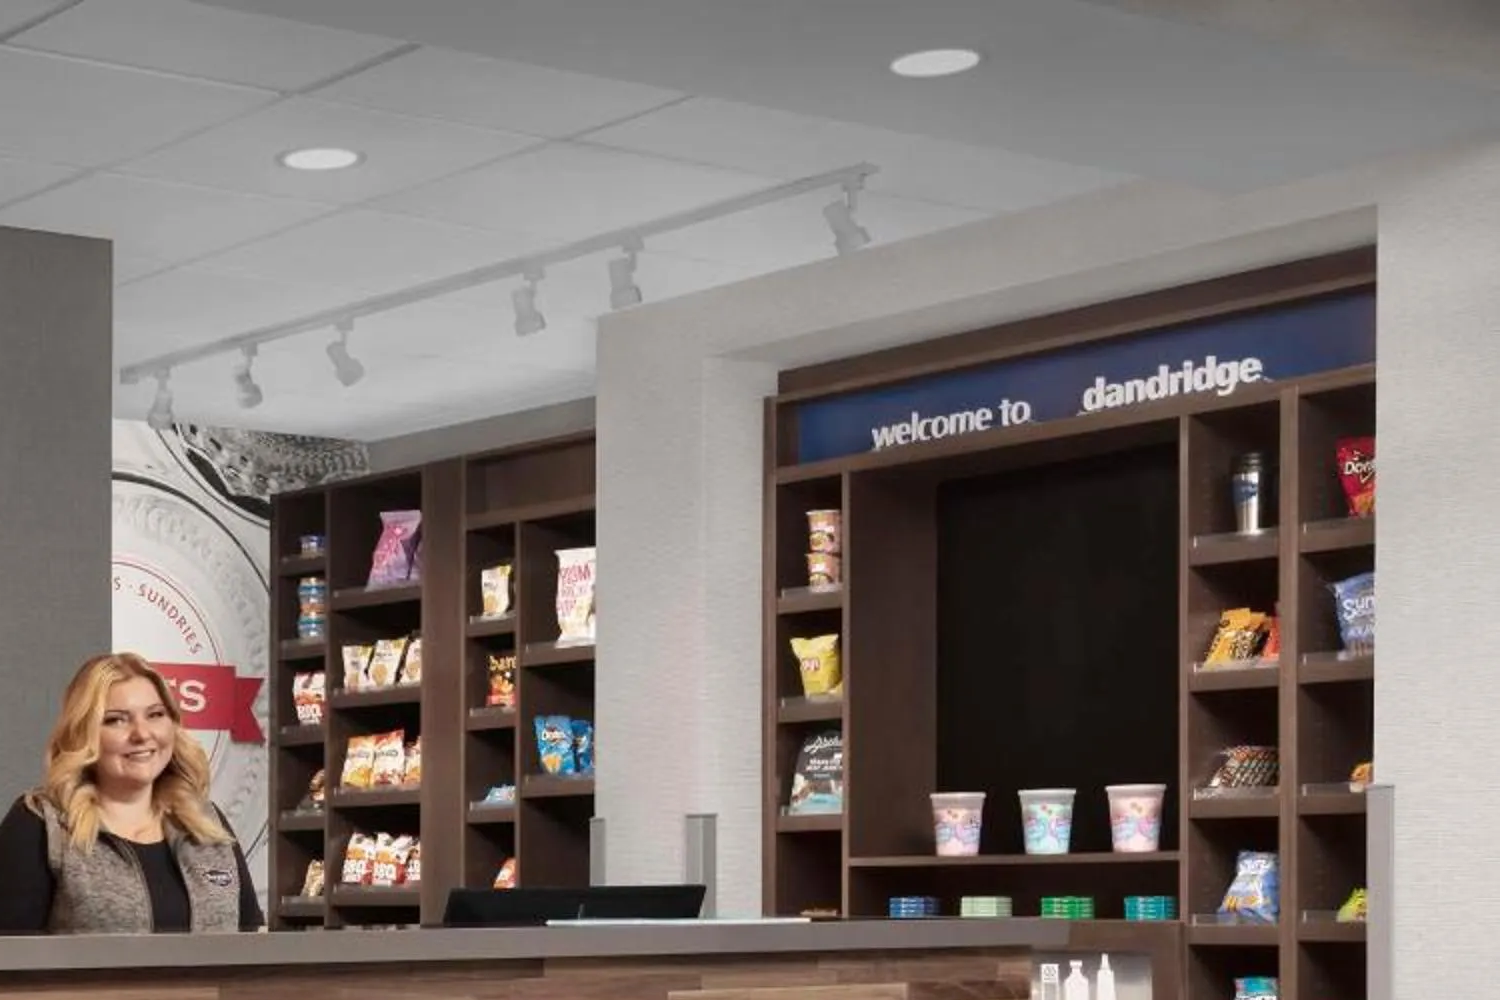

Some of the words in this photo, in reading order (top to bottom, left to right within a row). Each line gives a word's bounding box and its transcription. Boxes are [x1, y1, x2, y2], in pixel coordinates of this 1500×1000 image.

[1082, 355, 1264, 413] dandridge
[871, 411, 993, 451] welcome
[1001, 397, 1032, 428] to
[138, 583, 204, 655] SUNDRIES
